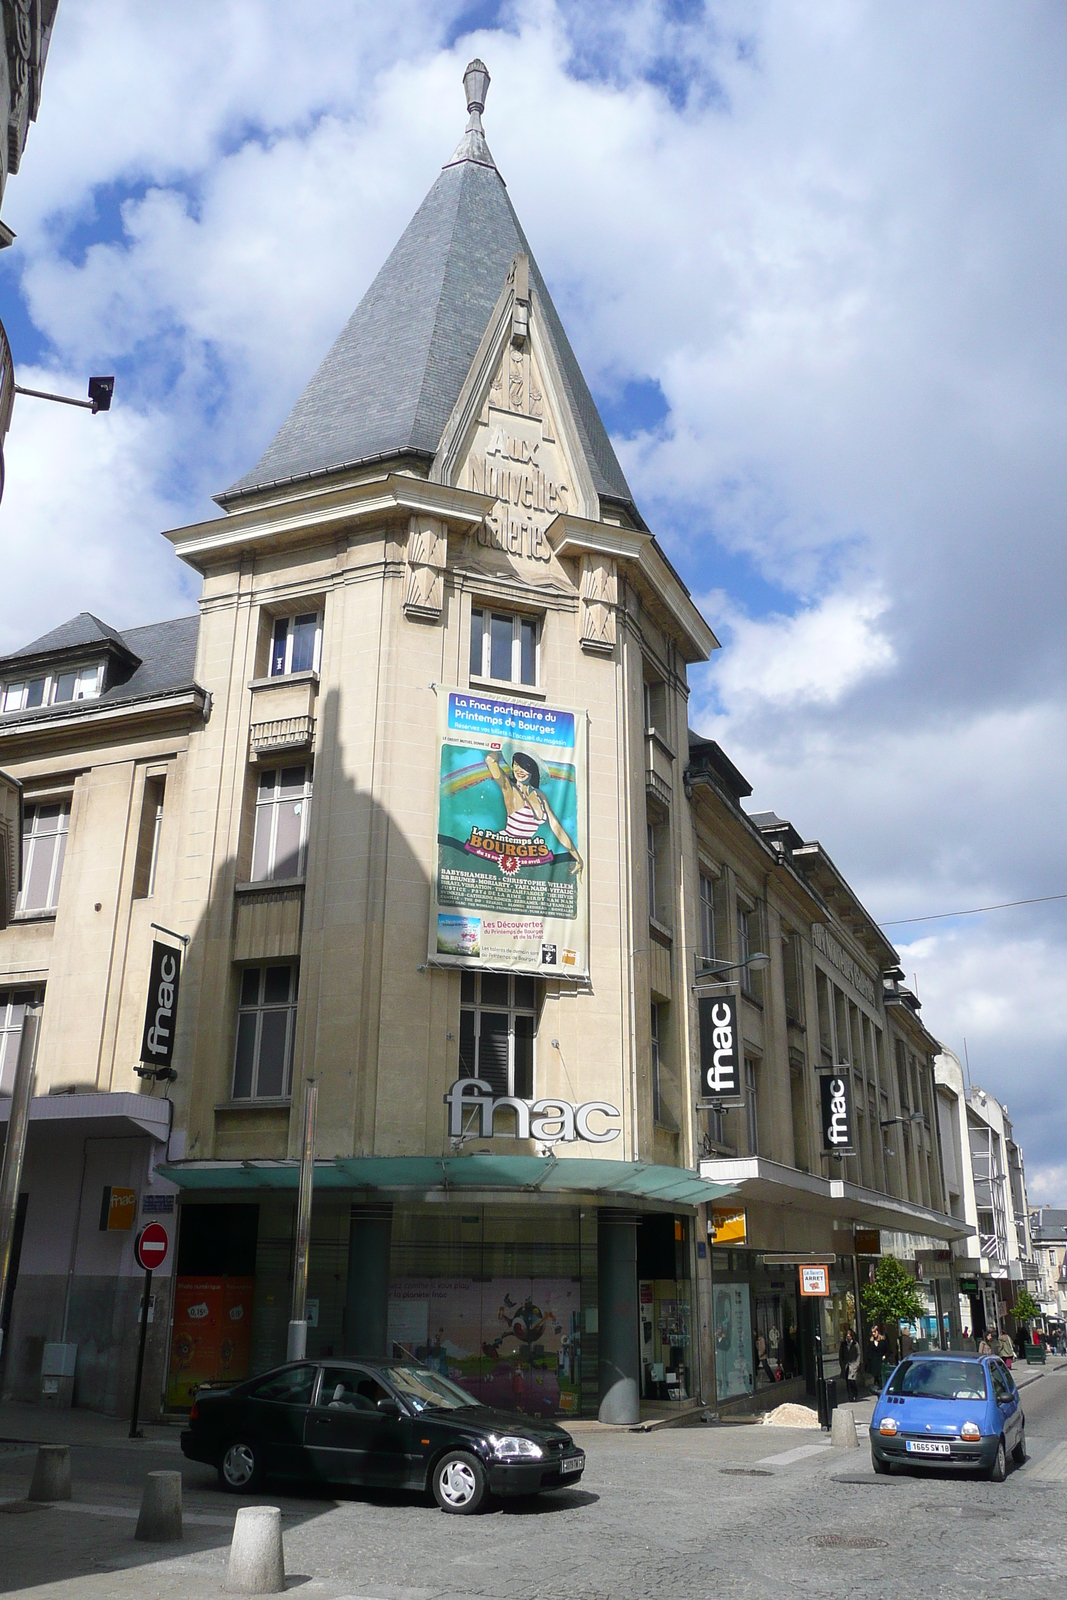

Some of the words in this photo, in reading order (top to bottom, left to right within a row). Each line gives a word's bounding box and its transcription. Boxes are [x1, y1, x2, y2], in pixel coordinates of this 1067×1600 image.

[486, 424, 540, 469] Aux
[455, 696, 467, 707] La
[469, 699, 492, 712] Fnac
[493, 705, 543, 721] partenaire
[545, 712, 557, 722] du
[455, 709, 503, 726] Printemps
[504, 717, 516, 728] de
[518, 720, 555, 735] Bourges
[454, 722, 480, 732] Réservez
[543, 738, 567, 746] magasin
[470, 834, 550, 857] BOURGES
[472, 826, 484, 837] Le
[485, 830, 532, 846] Printemps
[533, 837, 545, 845] de
[441, 869, 497, 881] BABYSHAMBLES
[502, 877, 547, 886] CHRISTOPHE
[548, 882, 573, 890] WILLEM
[441, 885, 467, 893] JUSTICE
[497, 920, 543, 928] Découvertes
[147, 954, 176, 1055] fnac
[707, 1002, 735, 1092] fnac
[443, 1077, 621, 1143] fnac
[828, 1078, 849, 1144] fnac
[110, 1194, 135, 1208] fnac
[712, 1212, 745, 1225] fnac
[194, 1283, 221, 1291] numérique
[912, 1442, 930, 1451] 1665
[931, 1444, 940, 1452] SW
